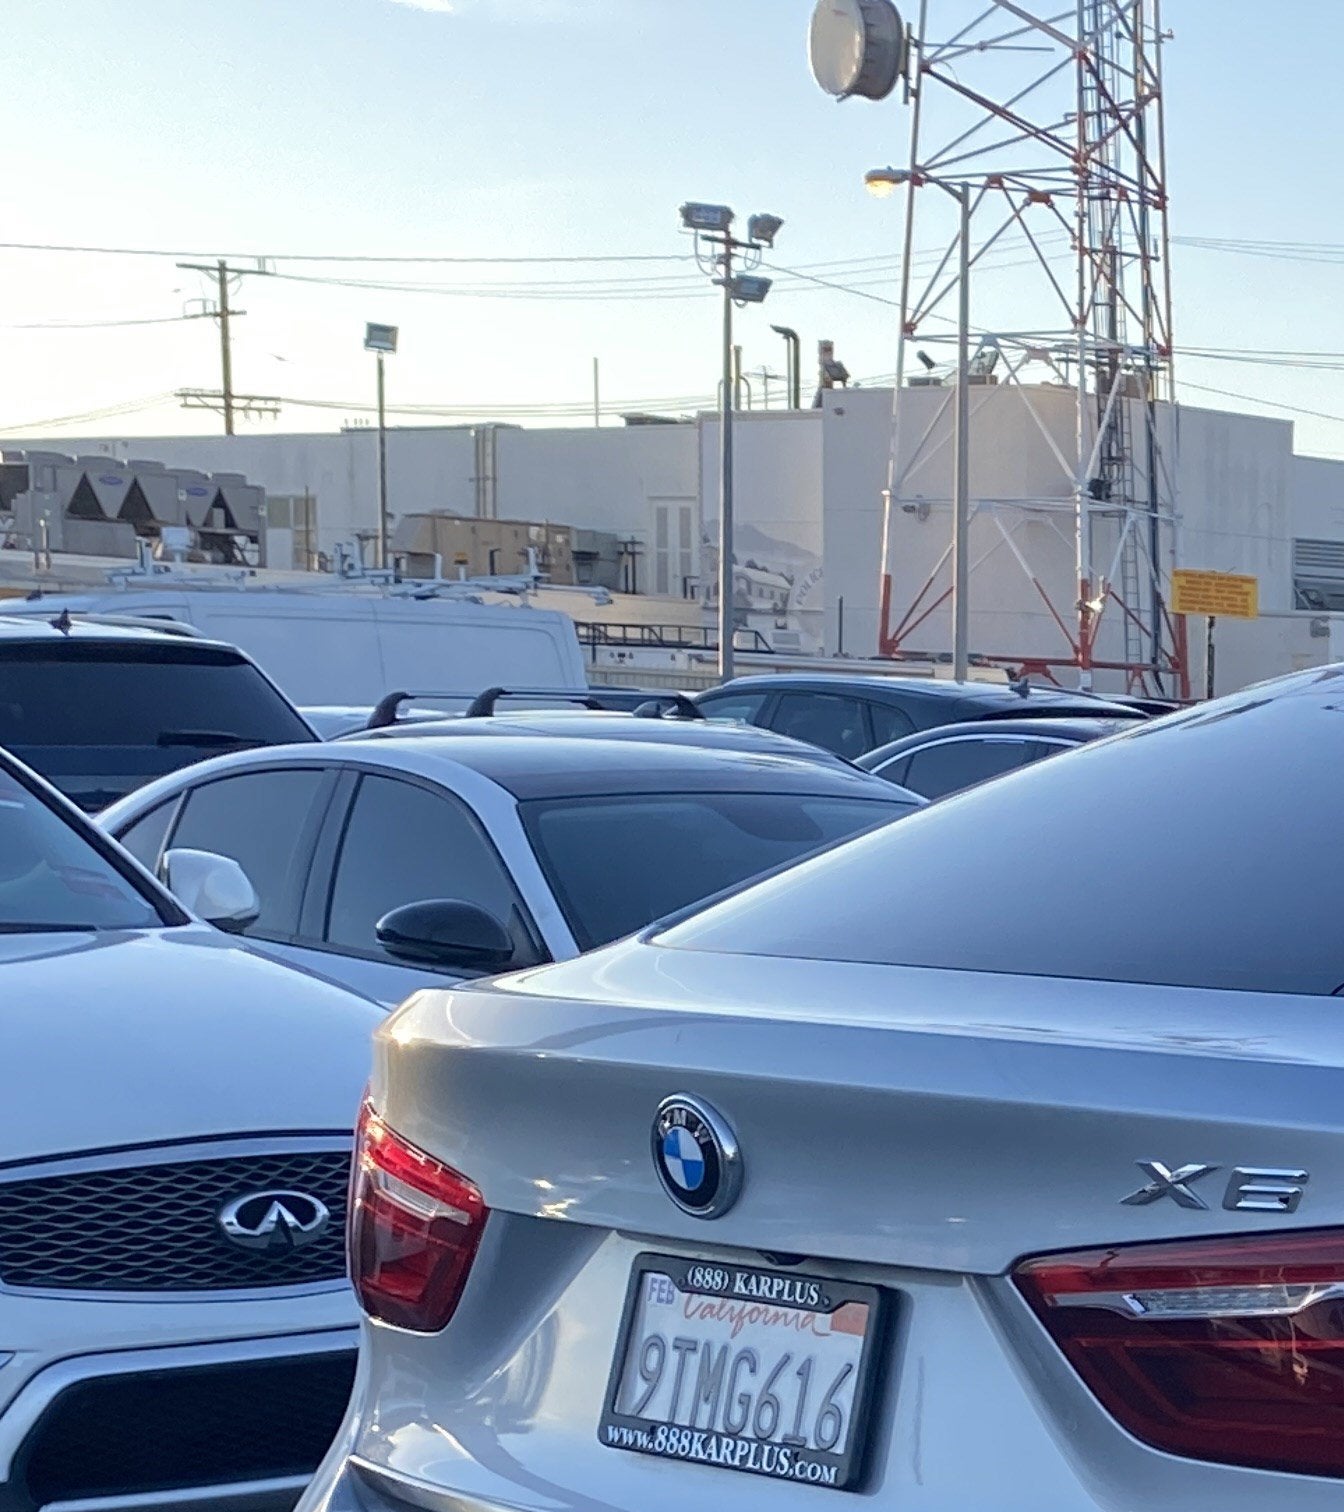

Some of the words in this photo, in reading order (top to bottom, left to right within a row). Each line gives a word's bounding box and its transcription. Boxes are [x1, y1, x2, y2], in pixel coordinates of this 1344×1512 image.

[1119, 1161, 1309, 1214] X6
[648, 1277, 675, 1305] FEB
[687, 1265, 729, 1291] (888)
[733, 1271, 819, 1306] KARPLUS
[683, 1292, 835, 1339] California
[632, 1333, 853, 1451] 9TMG616
